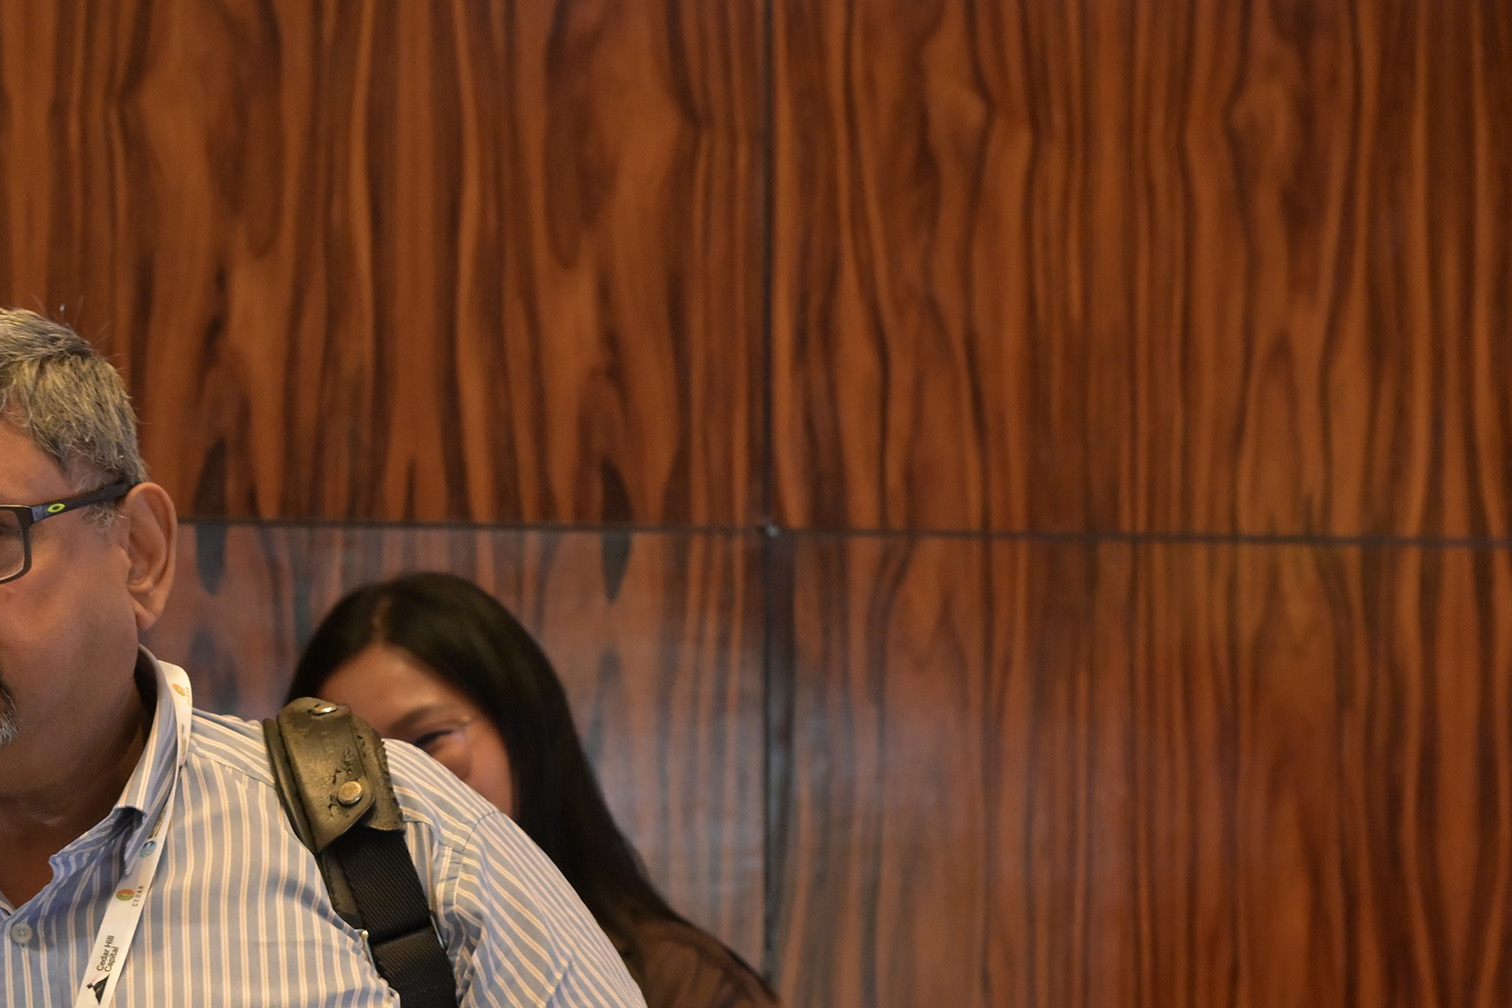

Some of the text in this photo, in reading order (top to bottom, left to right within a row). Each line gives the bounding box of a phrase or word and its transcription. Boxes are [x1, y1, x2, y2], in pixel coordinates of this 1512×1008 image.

[96, 935, 115, 971] Cedar Hill
[104, 946, 119, 972] Capital
